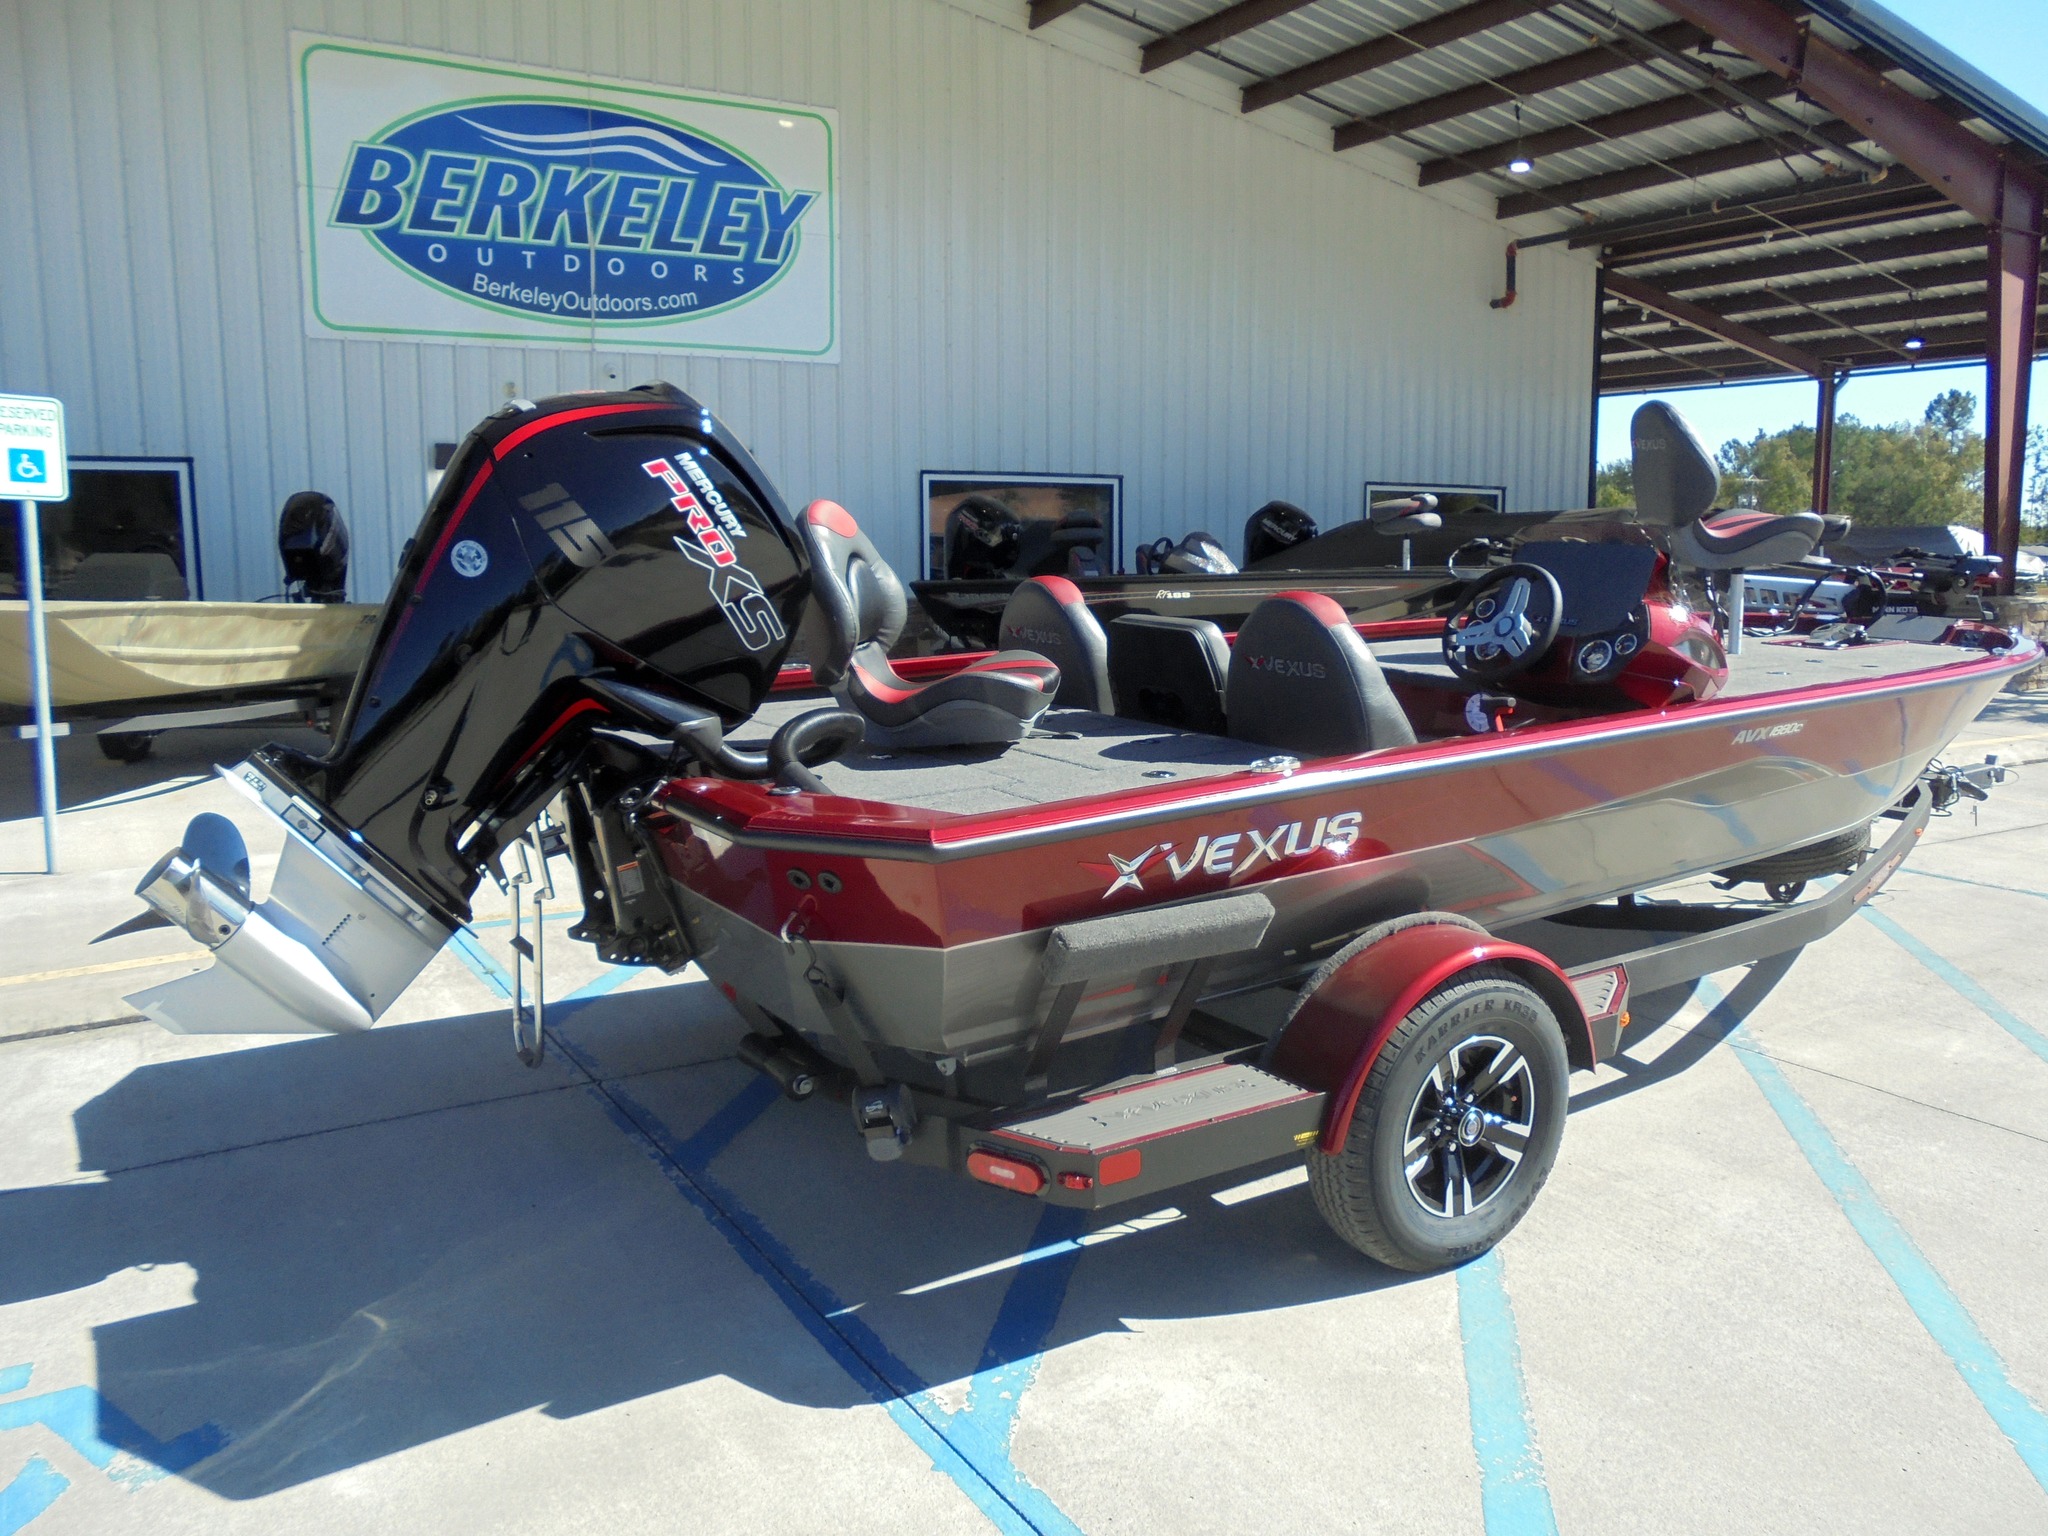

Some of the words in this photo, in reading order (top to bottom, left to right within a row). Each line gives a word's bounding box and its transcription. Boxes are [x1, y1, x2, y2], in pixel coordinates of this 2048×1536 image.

[326, 140, 822, 266] BERKELEY
[427, 242, 746, 285] OUTDOORS
[472, 272, 699, 313] BerkeleyOutdoors.com
[0, 406, 55, 421] ESERVED
[518, 482, 617, 567] 115
[641, 457, 737, 568] PRO
[674, 451, 747, 538] MERCURY
[672, 524, 786, 651] XS
[1264, 655, 1326, 679] VEXUS
[1160, 811, 1363, 882] VEXUS
[1414, 999, 1495, 1065] KARRIER
